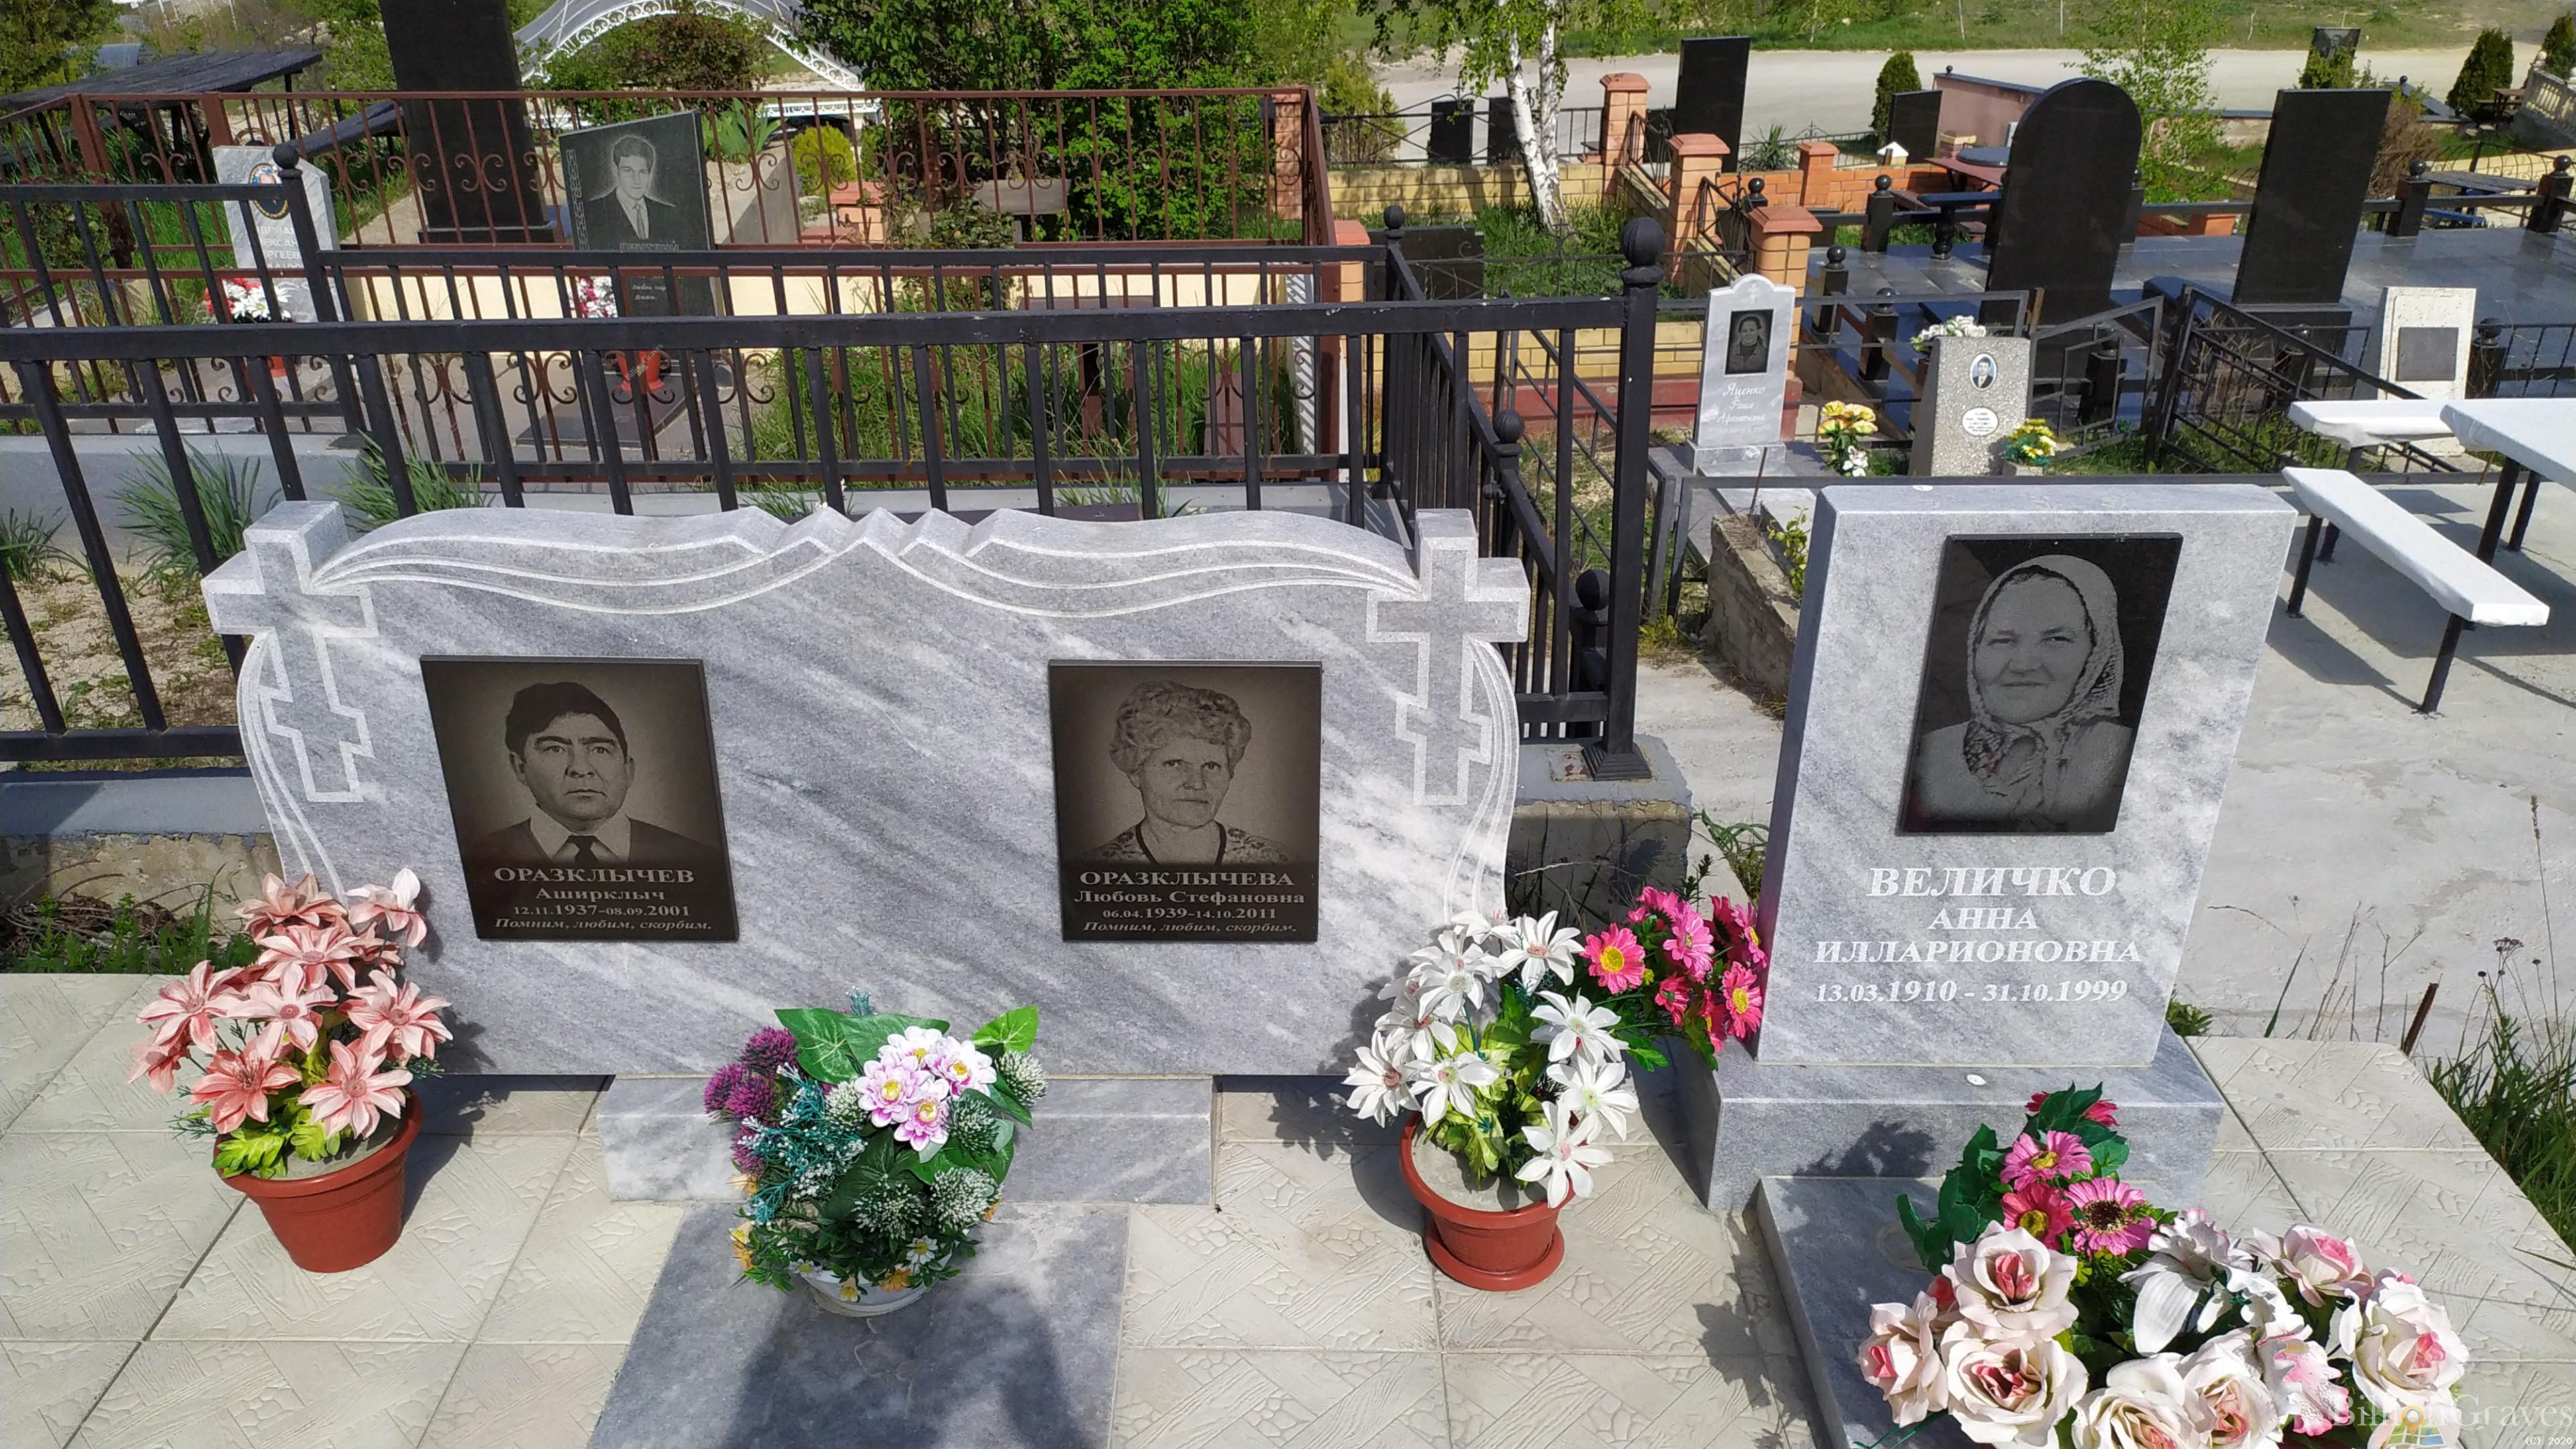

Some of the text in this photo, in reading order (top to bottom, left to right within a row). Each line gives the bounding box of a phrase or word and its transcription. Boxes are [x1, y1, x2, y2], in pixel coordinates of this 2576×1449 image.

[1722, 382, 1766, 398] Яценко
[494, 867, 695, 884] ОРАЗКЛЫЧЕВ
[1079, 871, 1295, 886] ОРАЗКЛЫЧЕВА
[1865, 866, 2117, 897] ВЕЛИЧКО
[535, 887, 665, 902] Аширклыч
[1073, 890, 1305, 907] Любовь Стефановна
[494, 918, 713, 931] Помним, любим, скорбим.
[1926, 907, 2039, 930] АННА
[1083, 922, 1297, 934] Помним, любим, скорбим.
[1813, 941, 2142, 963] ИЛЛАРИОНОВНА
[1813, 980, 1958, 1003] 13.03.1910
[1981, 979, 2129, 1003] 31.10.1999
